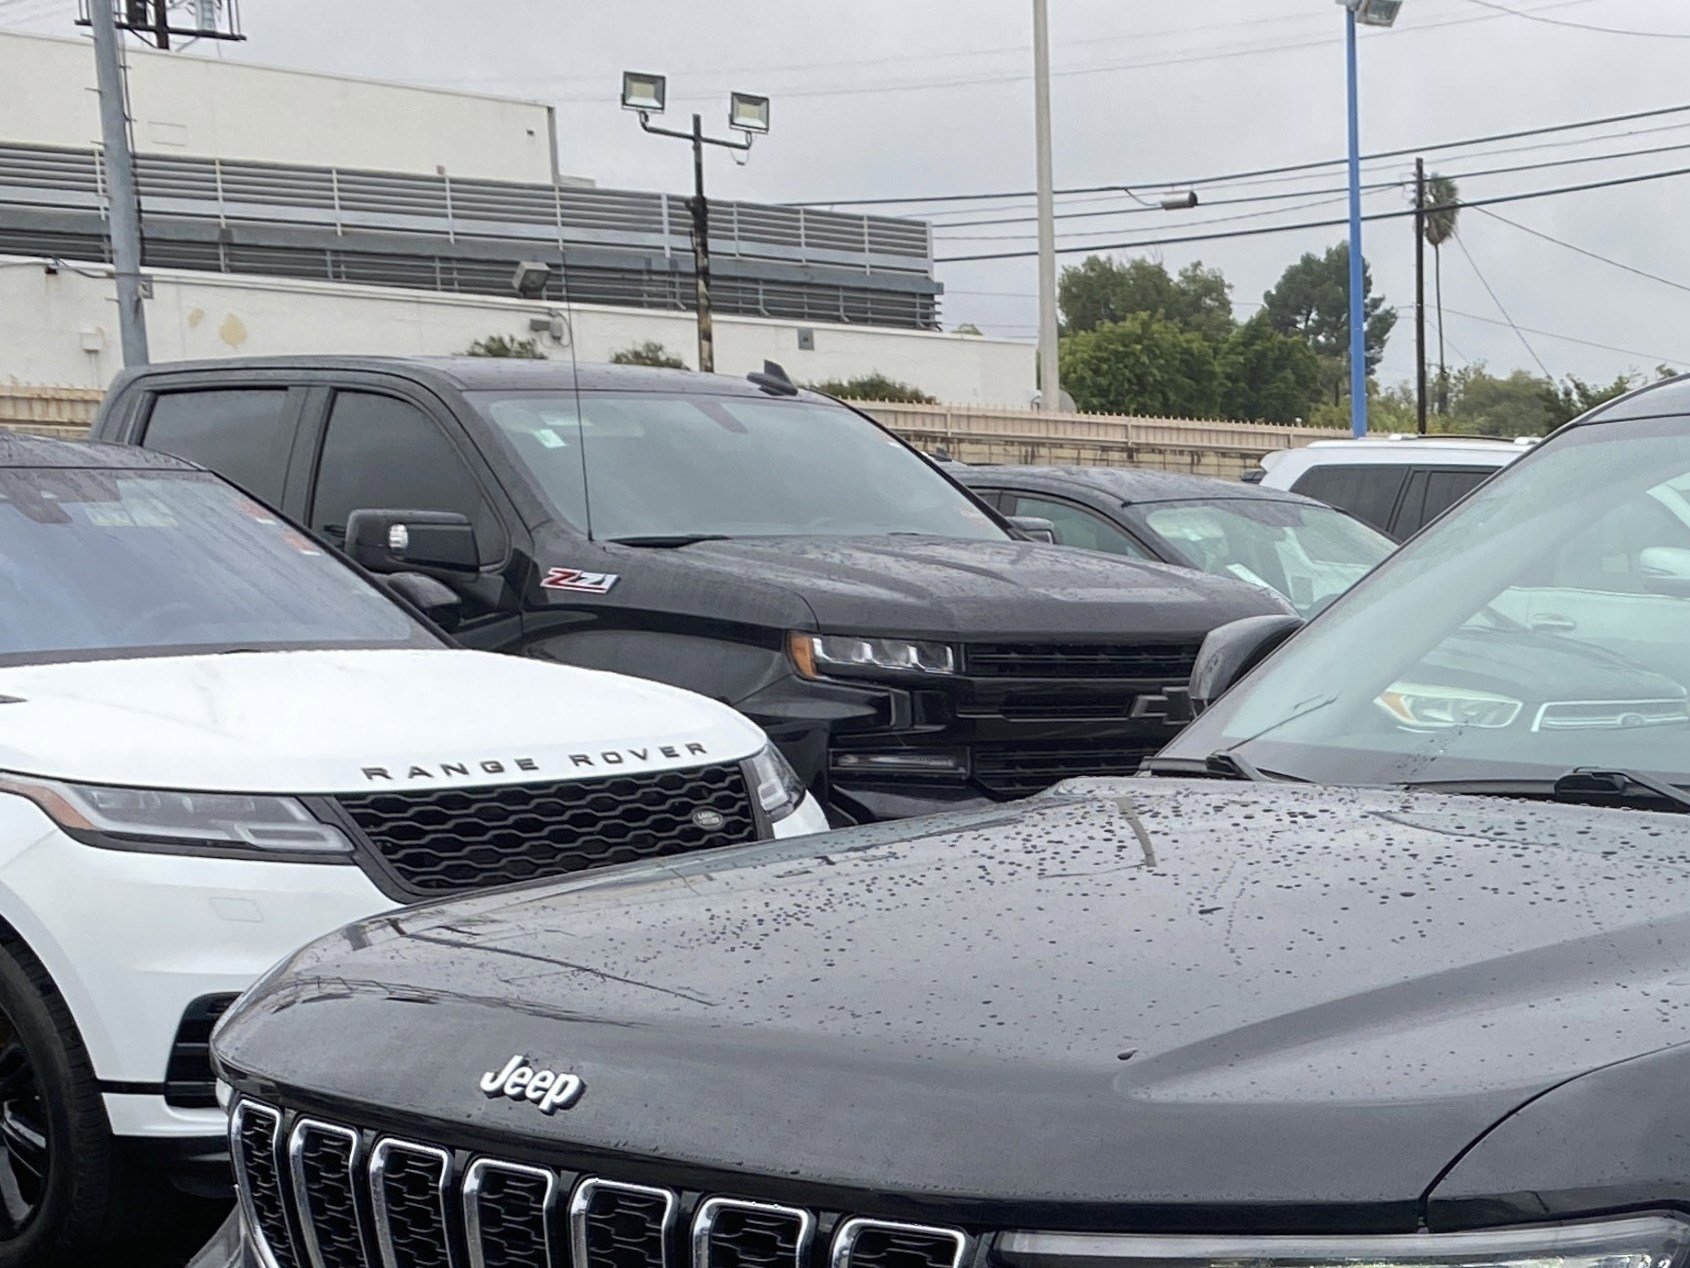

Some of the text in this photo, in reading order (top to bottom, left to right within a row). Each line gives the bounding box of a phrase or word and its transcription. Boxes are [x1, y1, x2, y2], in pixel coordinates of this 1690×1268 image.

[540, 567, 620, 594] Z71
[361, 742, 708, 781] RANGE ROVER
[480, 1054, 583, 1112] Jeep
